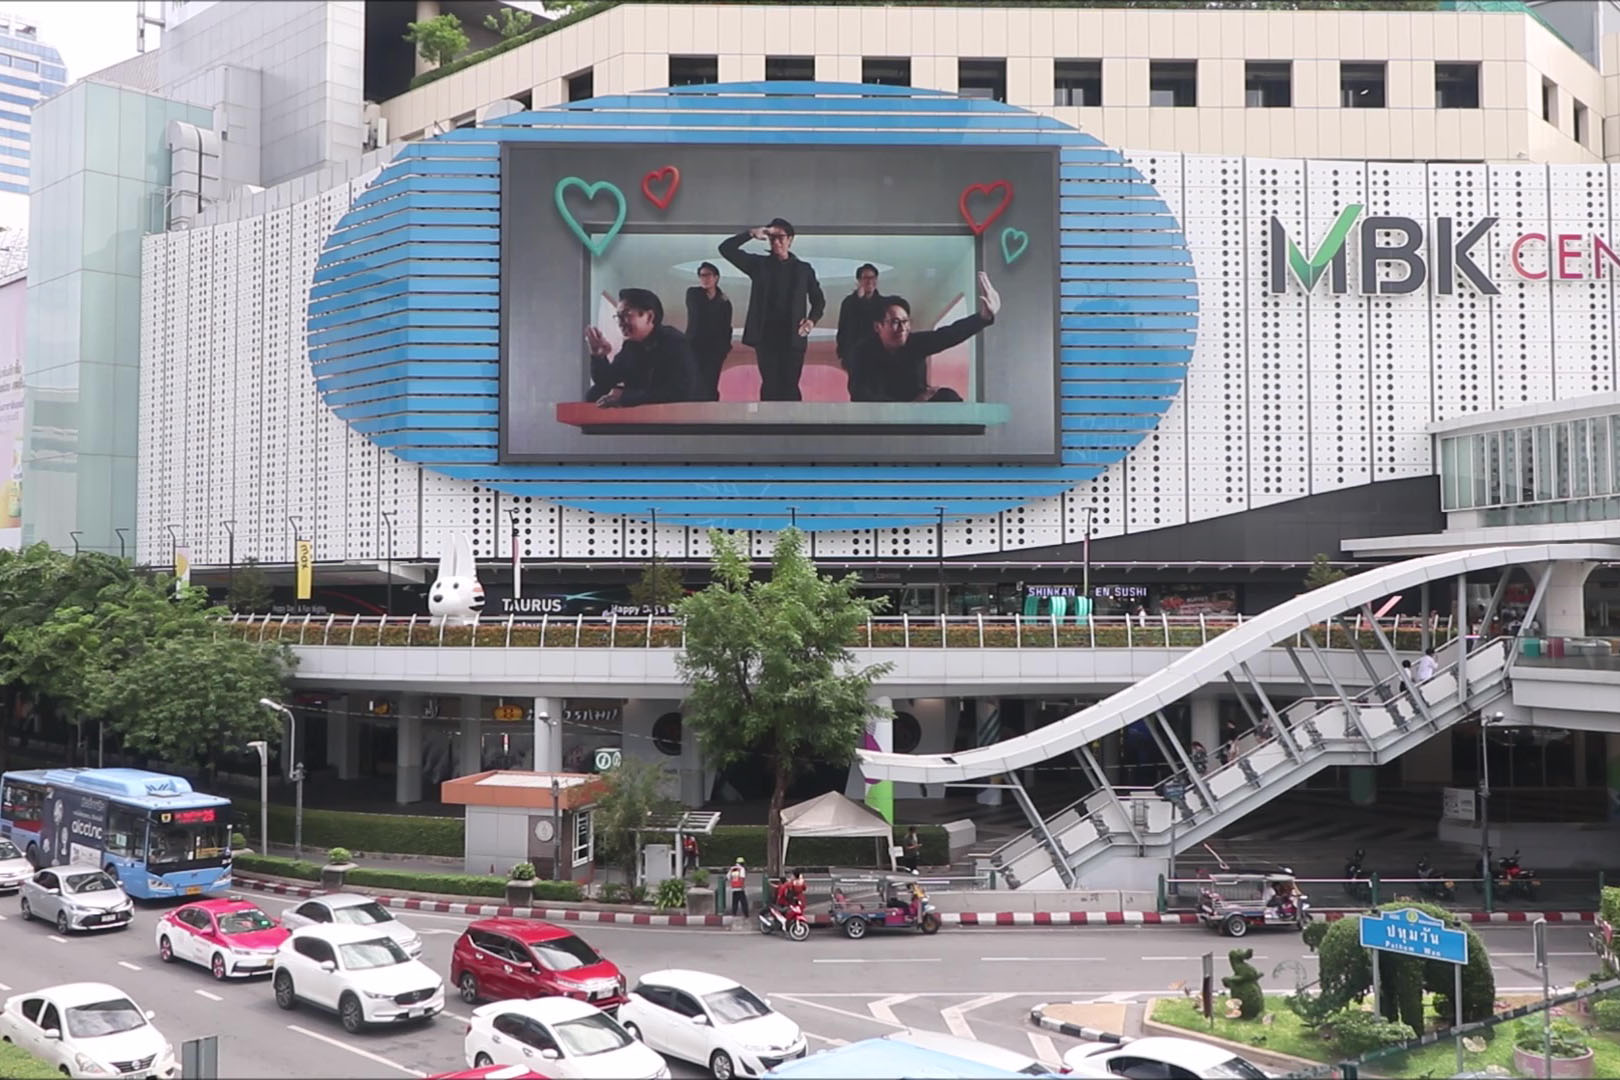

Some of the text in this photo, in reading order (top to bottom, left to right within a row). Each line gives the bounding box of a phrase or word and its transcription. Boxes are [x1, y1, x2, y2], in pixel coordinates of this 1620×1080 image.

[1271, 204, 1501, 295] MBK
[1114, 586, 1147, 597] SUSHI
[501, 598, 562, 612] TAURUS
[611, 604, 640, 615] Happy
[1387, 924, 1439, 944] ปทุมวัน
